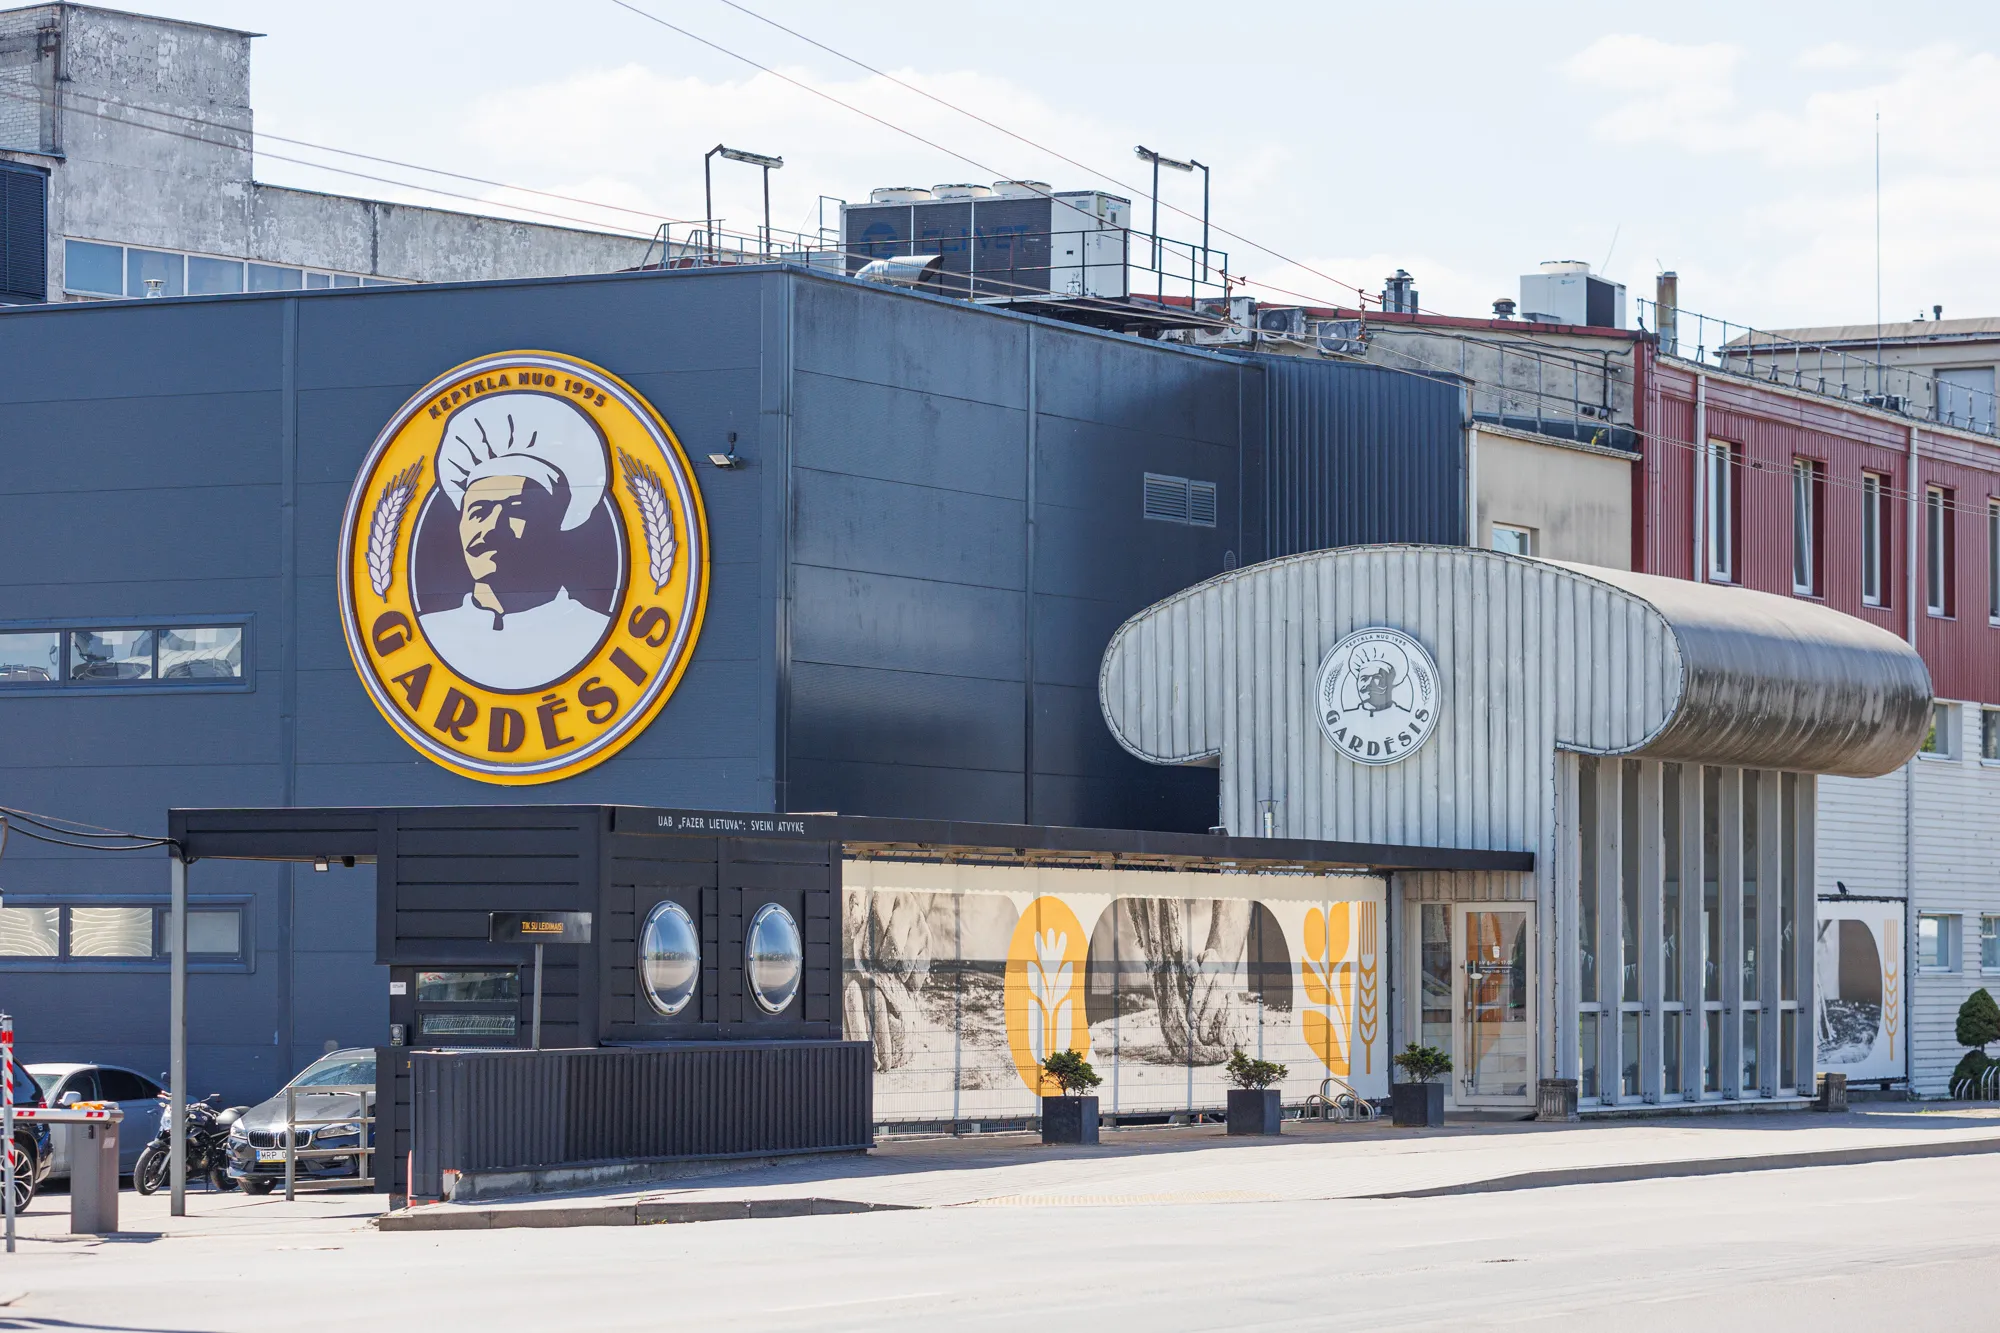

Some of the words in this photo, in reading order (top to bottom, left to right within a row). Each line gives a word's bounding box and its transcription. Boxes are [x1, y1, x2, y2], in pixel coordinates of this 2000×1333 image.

[428, 374, 510, 420] KEPYKLA
[518, 372, 556, 388] NUO
[564, 379, 607, 408] 1995
[1345, 635, 1373, 649] KEPYKLA
[1392, 636, 1406, 647] 1995
[658, 816, 673, 827] UAB
[751, 820, 774, 832] SVEIKI
[778, 821, 805, 835] ATVYKĘ
[261, 1151, 277, 1160] MRP
